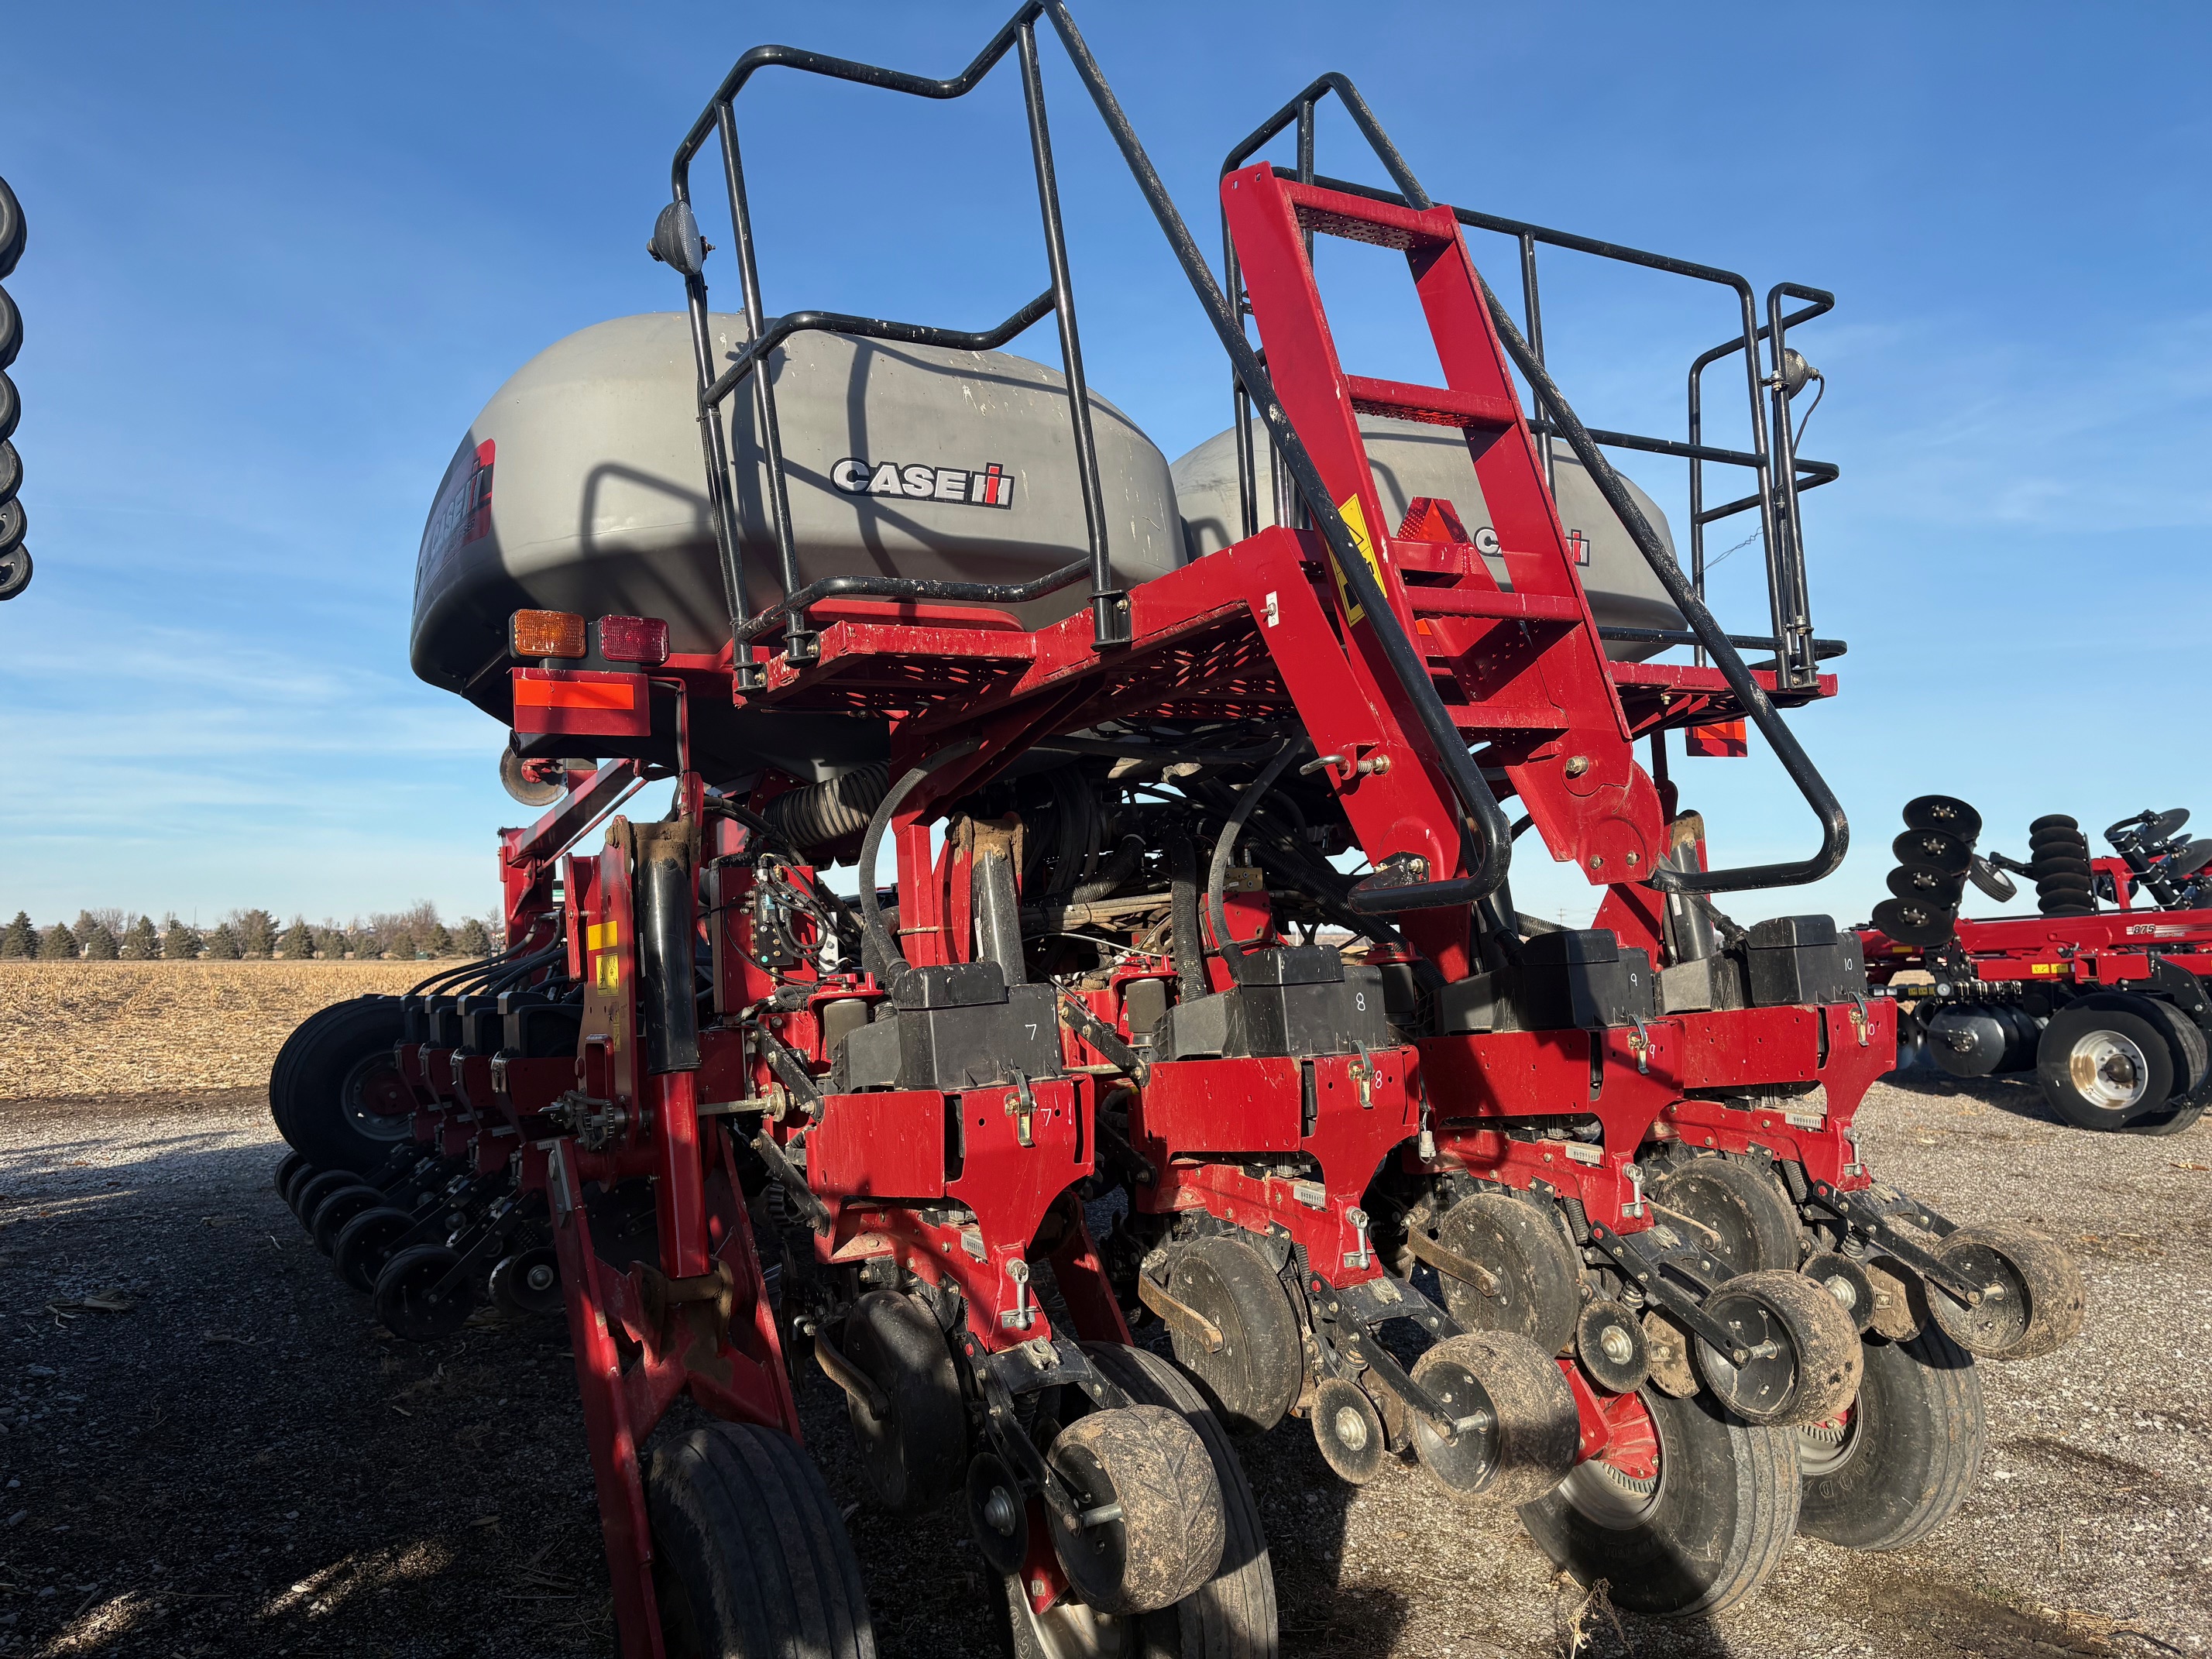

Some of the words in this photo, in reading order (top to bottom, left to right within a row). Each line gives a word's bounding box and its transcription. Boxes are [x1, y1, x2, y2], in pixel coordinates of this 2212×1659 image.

[832, 459, 967, 502] CASE
[2133, 923, 2155, 935] 875
[1843, 957, 1853, 972] 10
[1630, 972, 1638, 988] 9
[1355, 991, 1366, 1012] 8
[1024, 1023, 1038, 1042] 7
[1867, 1021, 1876, 1036] 10
[1648, 1043, 1657, 1060] 9
[1375, 1070, 1383, 1089] 8
[1039, 1108, 1053, 1127] 7
